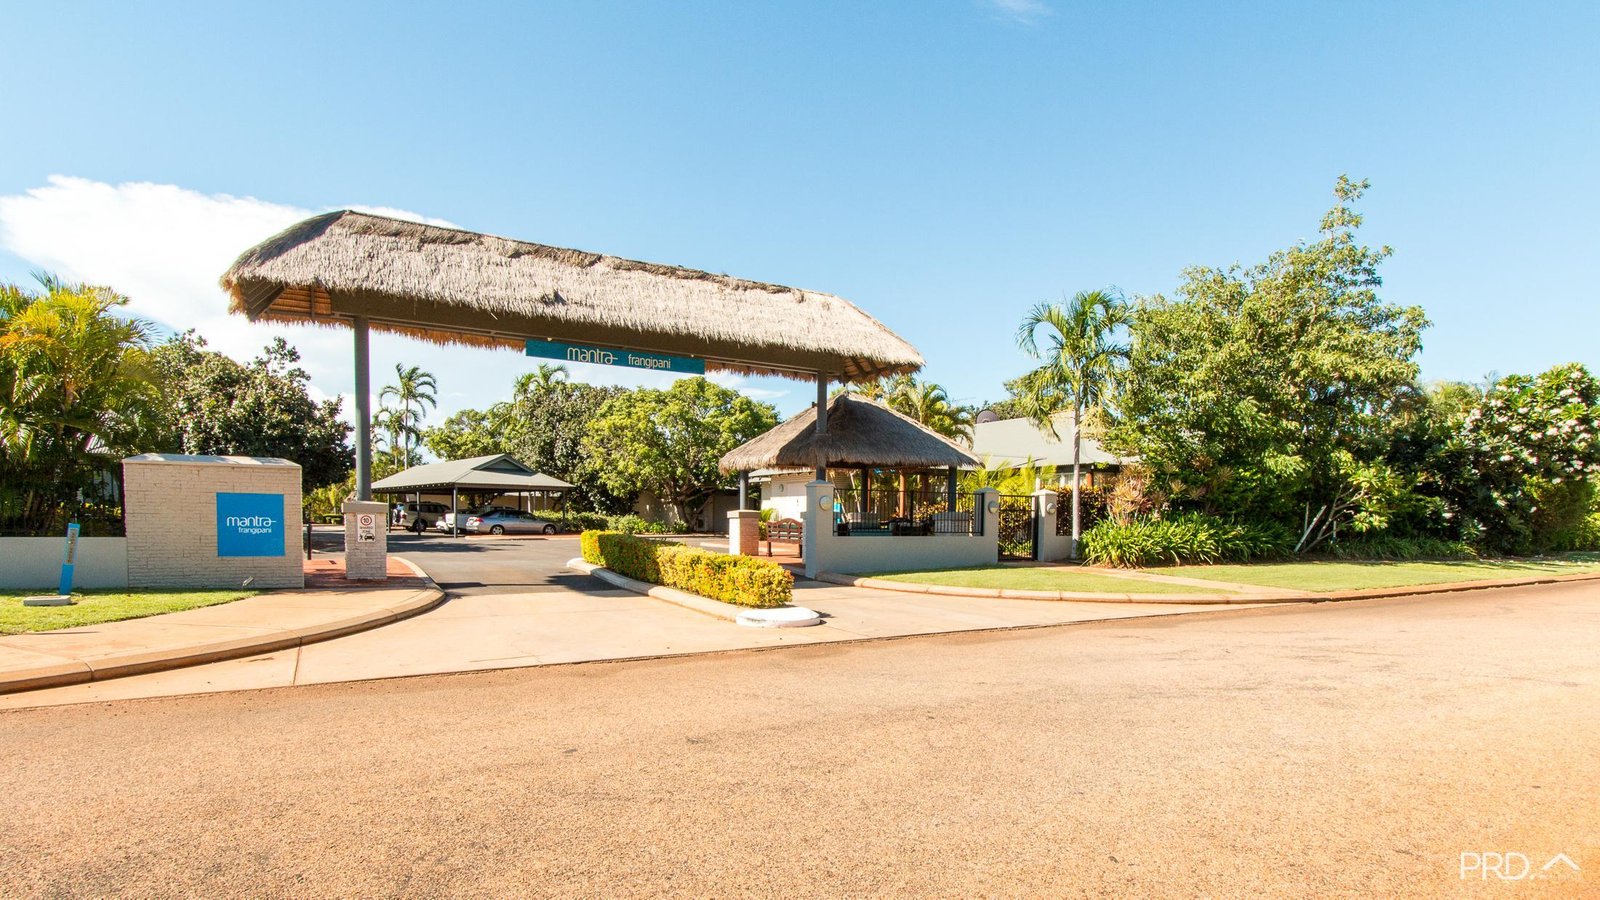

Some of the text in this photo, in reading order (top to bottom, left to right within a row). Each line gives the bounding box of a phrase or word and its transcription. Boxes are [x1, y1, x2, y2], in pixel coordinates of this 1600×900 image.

[567, 347, 671, 369] mantra frangipani
[226, 515, 276, 527] mantra
[238, 527, 272, 535] frangipani
